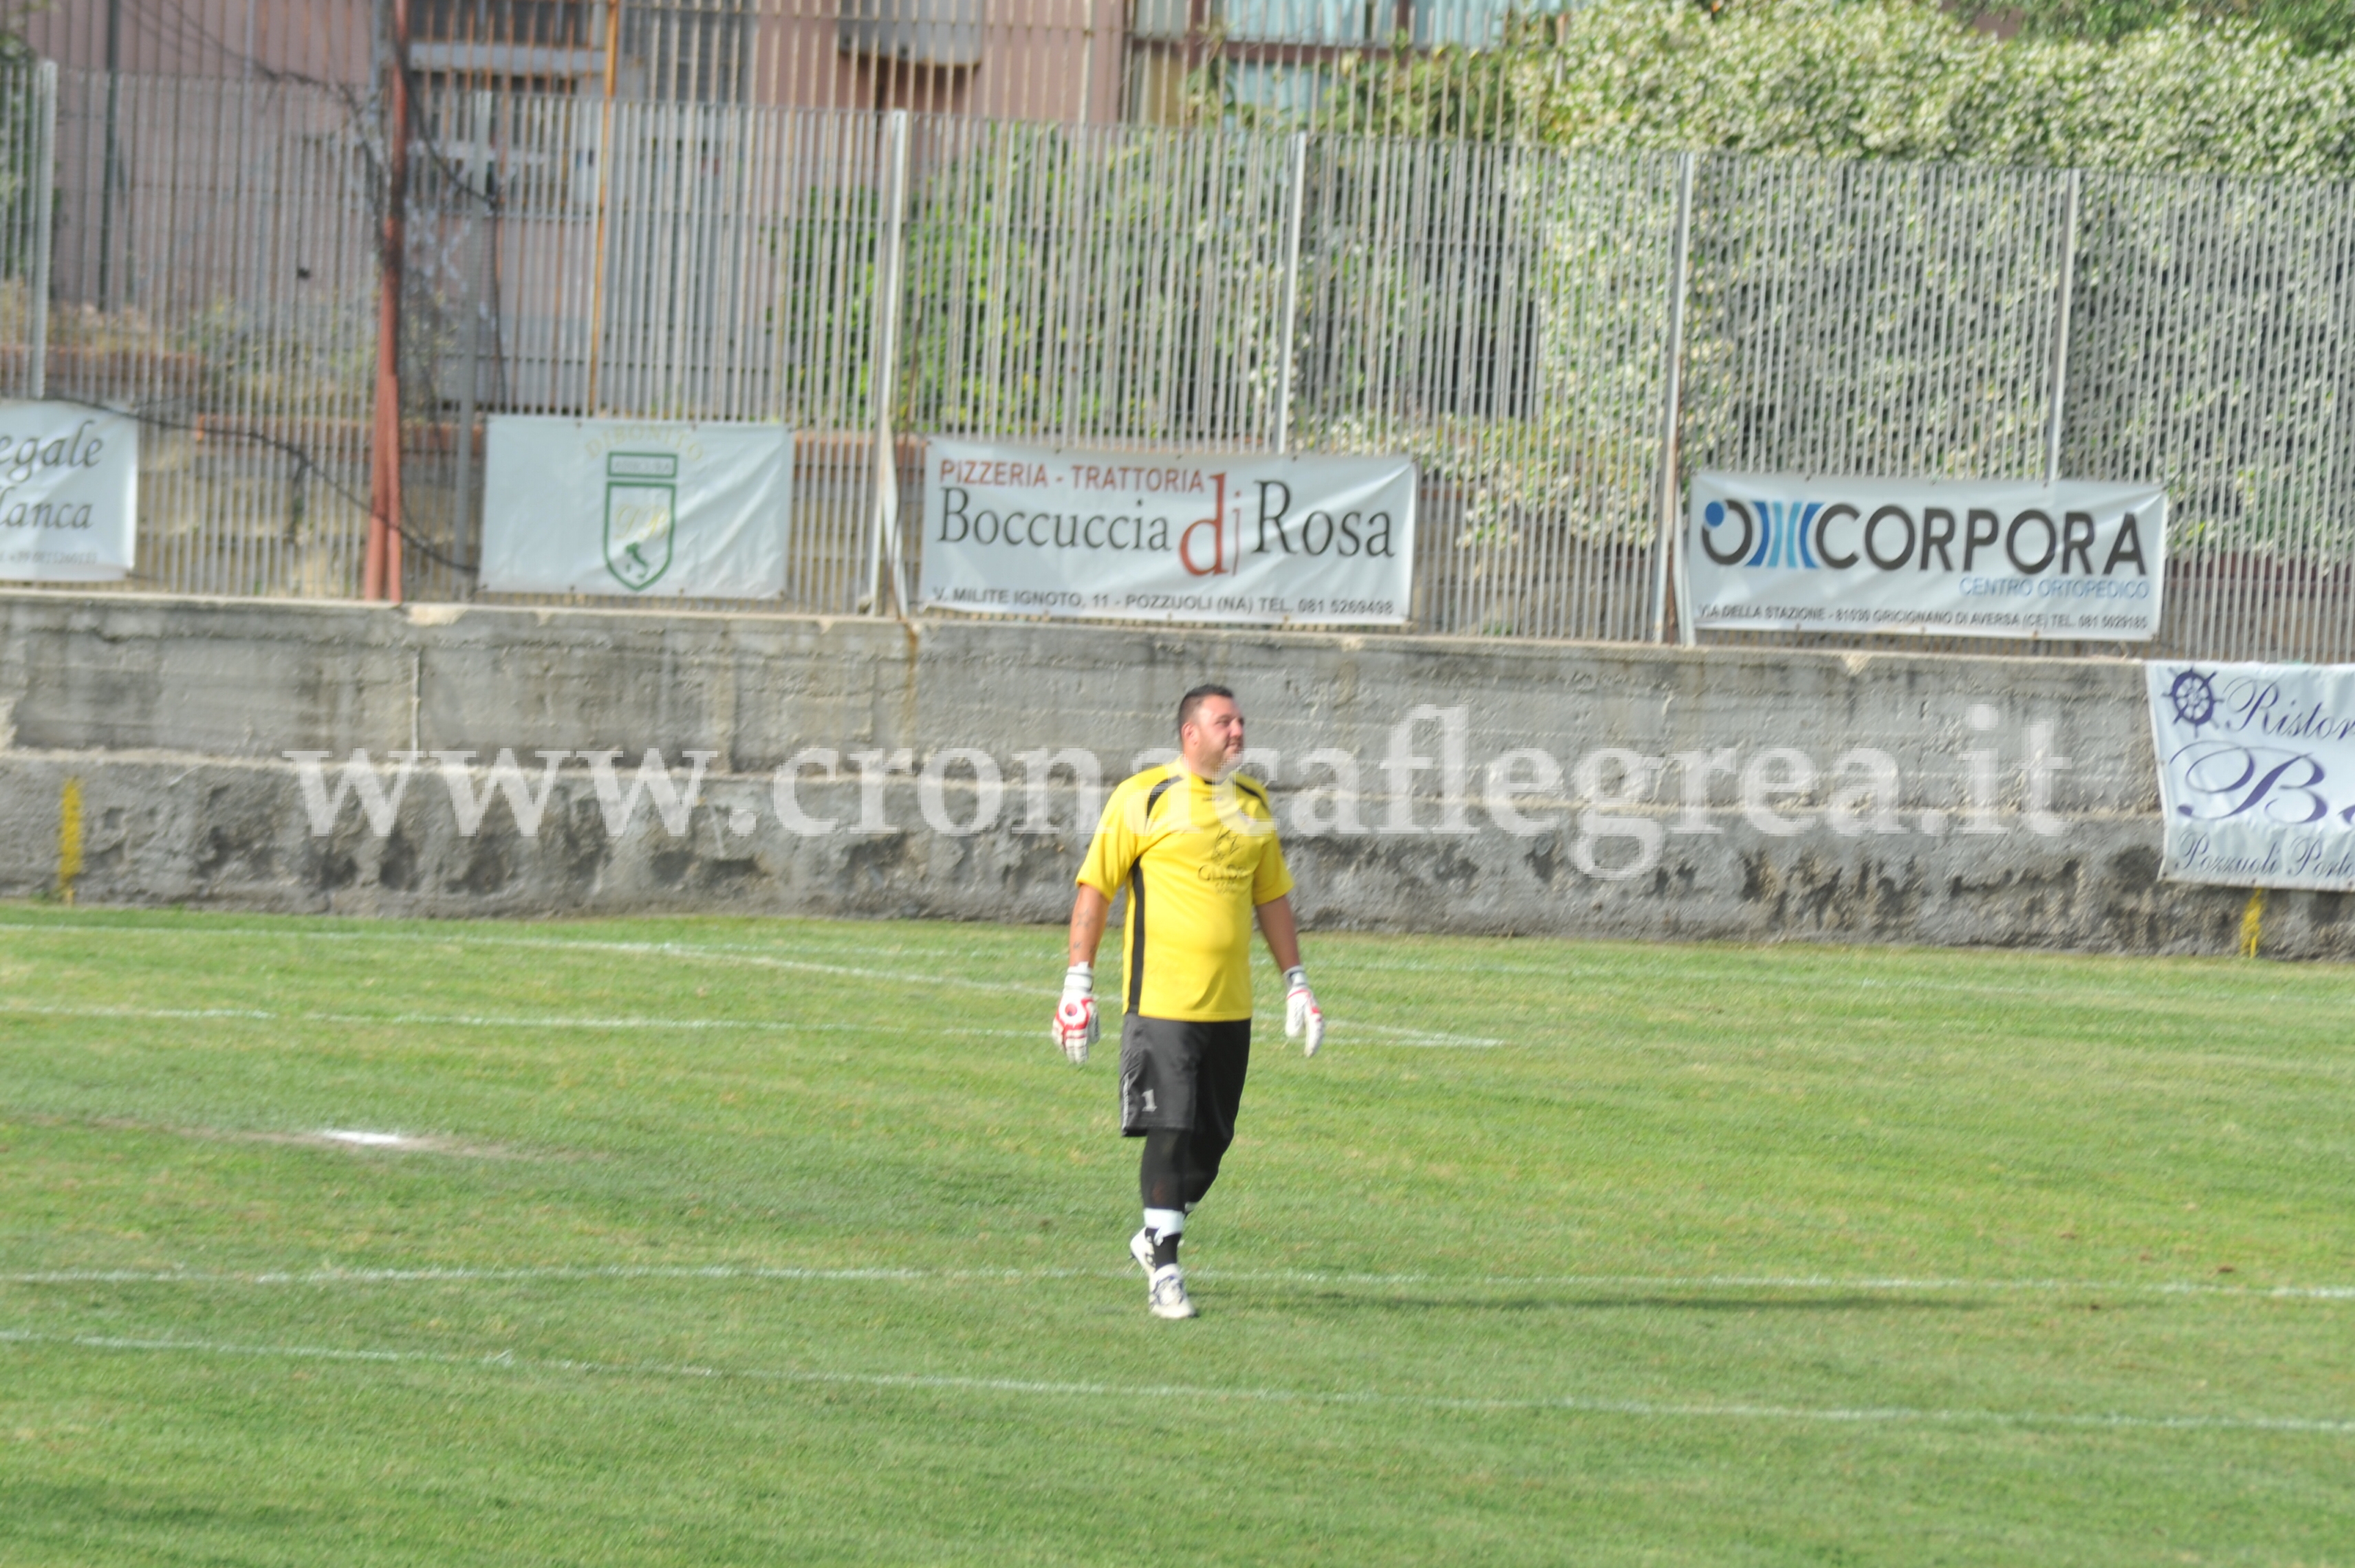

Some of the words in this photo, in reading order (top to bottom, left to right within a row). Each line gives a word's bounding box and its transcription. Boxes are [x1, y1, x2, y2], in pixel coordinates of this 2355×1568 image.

[940, 459, 1049, 488] PIZZERIA
[1070, 465, 1205, 493] TRATTORIA
[936, 486, 1172, 552] Boccuccia
[1252, 480, 1396, 558] Rosa
[1814, 503, 2147, 576] CORPORA
[953, 588, 1010, 604] MILITE
[1092, 594, 1109, 608] 11
[1125, 594, 1212, 611] POZZUOLI
[1217, 596, 1253, 615] (NA)
[1298, 598, 1324, 613] 081
[1959, 576, 2032, 598] CENTRO
[2037, 579, 2150, 600] ORTOPEDICO
[1722, 605, 1762, 619] DELLA
[1765, 606, 1826, 620] STAZIONE
[1955, 611, 1968, 626] DI
[1969, 612, 2019, 627] AVERSA
[2023, 612, 2049, 630] (CE)
[2169, 740, 2355, 825] B
[1141, 1089, 1158, 1112] 1
